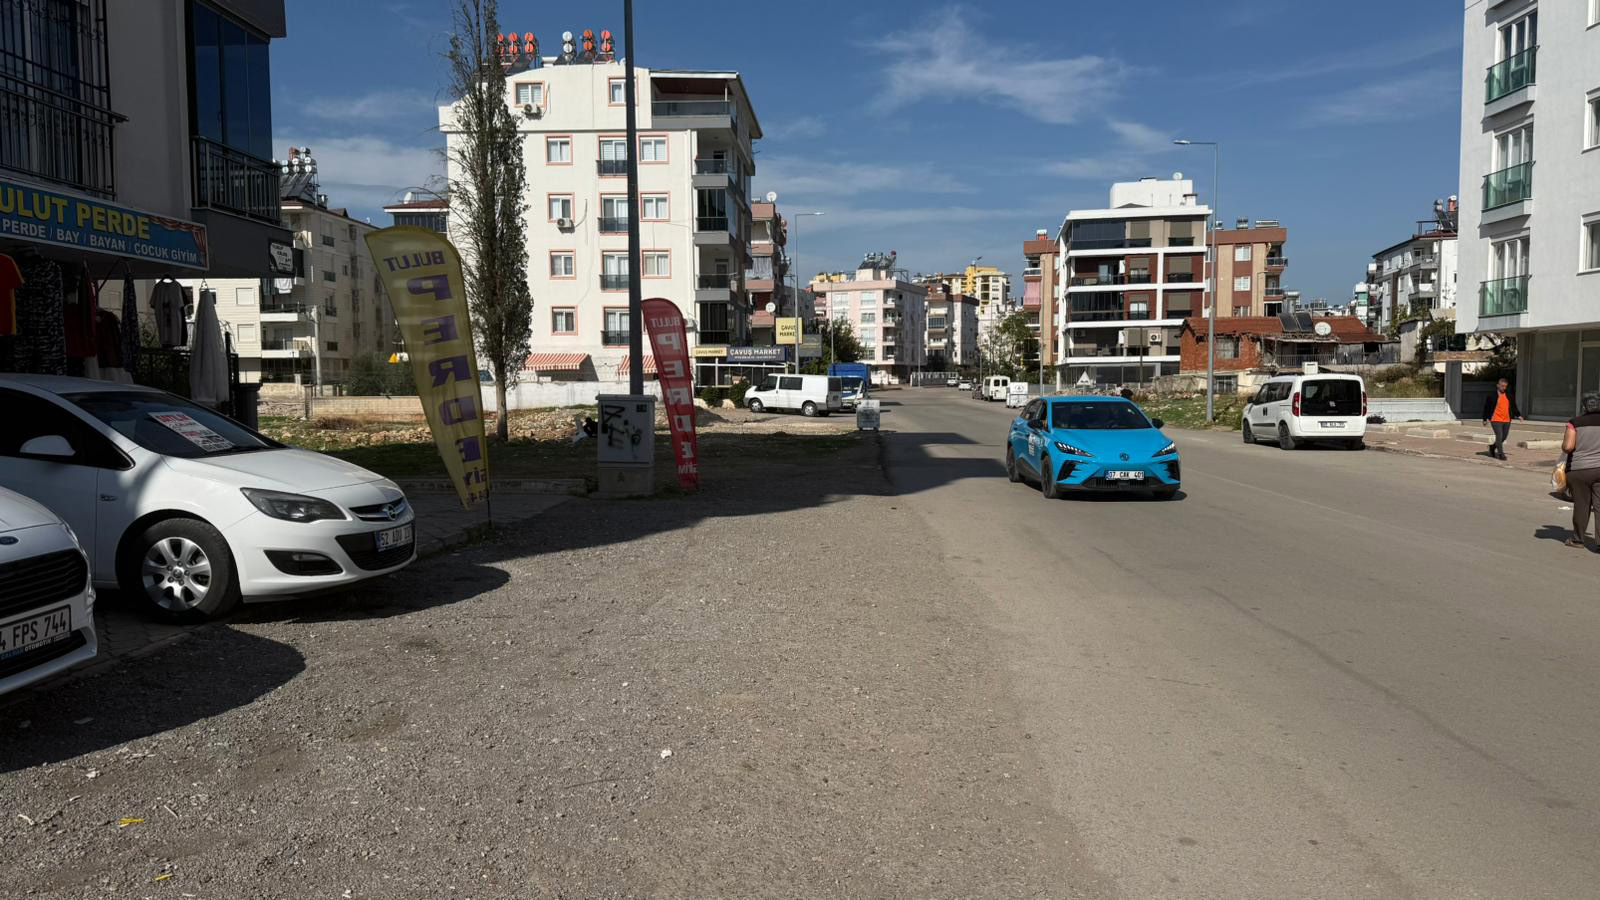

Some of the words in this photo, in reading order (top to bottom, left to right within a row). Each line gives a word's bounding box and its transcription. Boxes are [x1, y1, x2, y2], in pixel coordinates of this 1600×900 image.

[76, 202, 151, 240] PERDE
[2, 218, 46, 238] PERDE
[56, 230, 80, 244] BAY
[90, 234, 126, 251] BAYAN
[134, 242, 168, 259] ÇOCUK
[171, 247, 197, 263] GİYİM
[729, 348, 752, 356] ÇAVUŞ
[12, 620, 38, 647] FPS
[44, 612, 67, 637] 744
